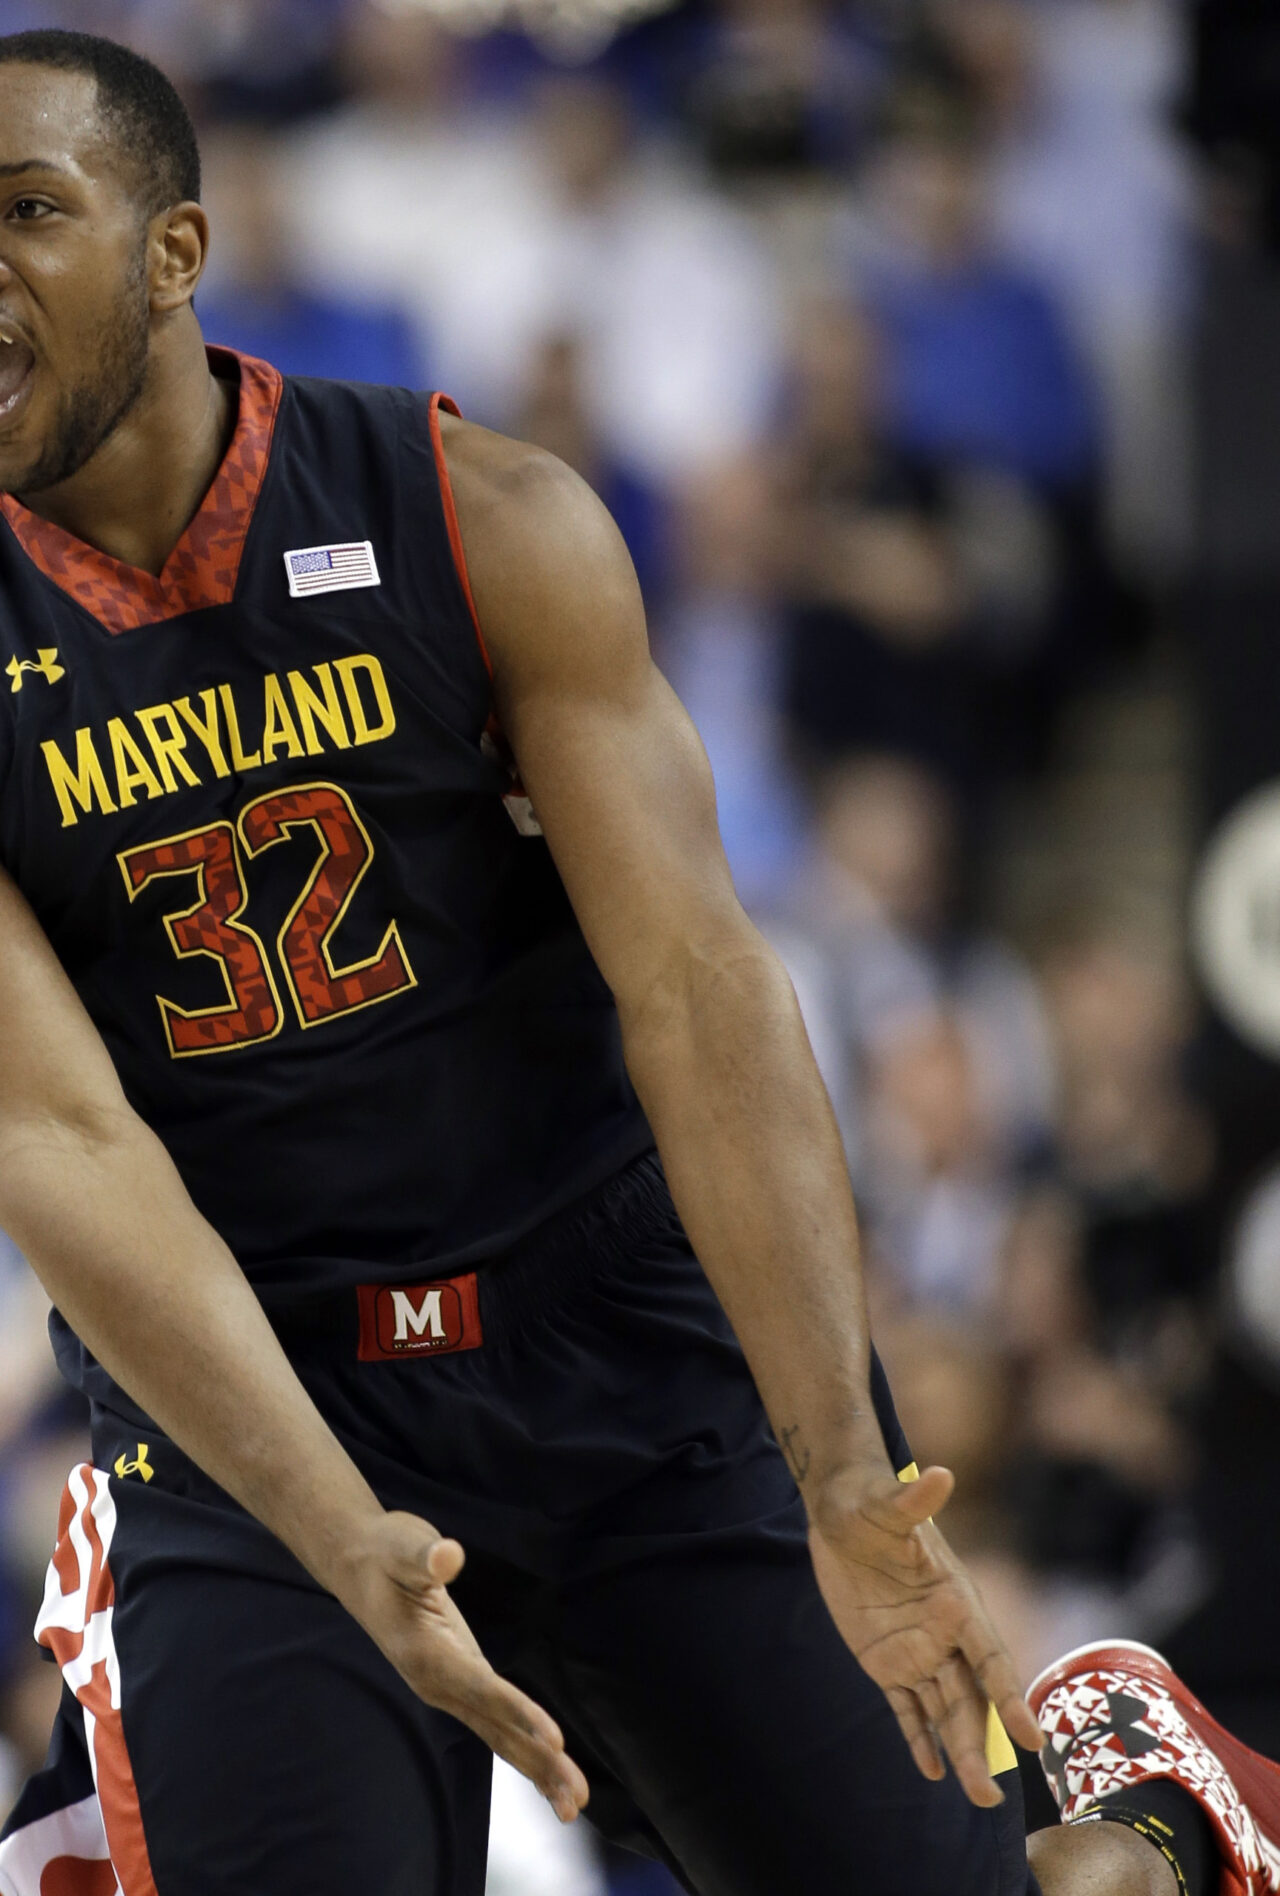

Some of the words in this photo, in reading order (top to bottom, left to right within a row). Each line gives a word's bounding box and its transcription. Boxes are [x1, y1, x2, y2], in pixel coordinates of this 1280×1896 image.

[40, 653, 396, 827] MARYLAND
[116, 781, 418, 1059] 32
[390, 1290, 446, 1340] M
